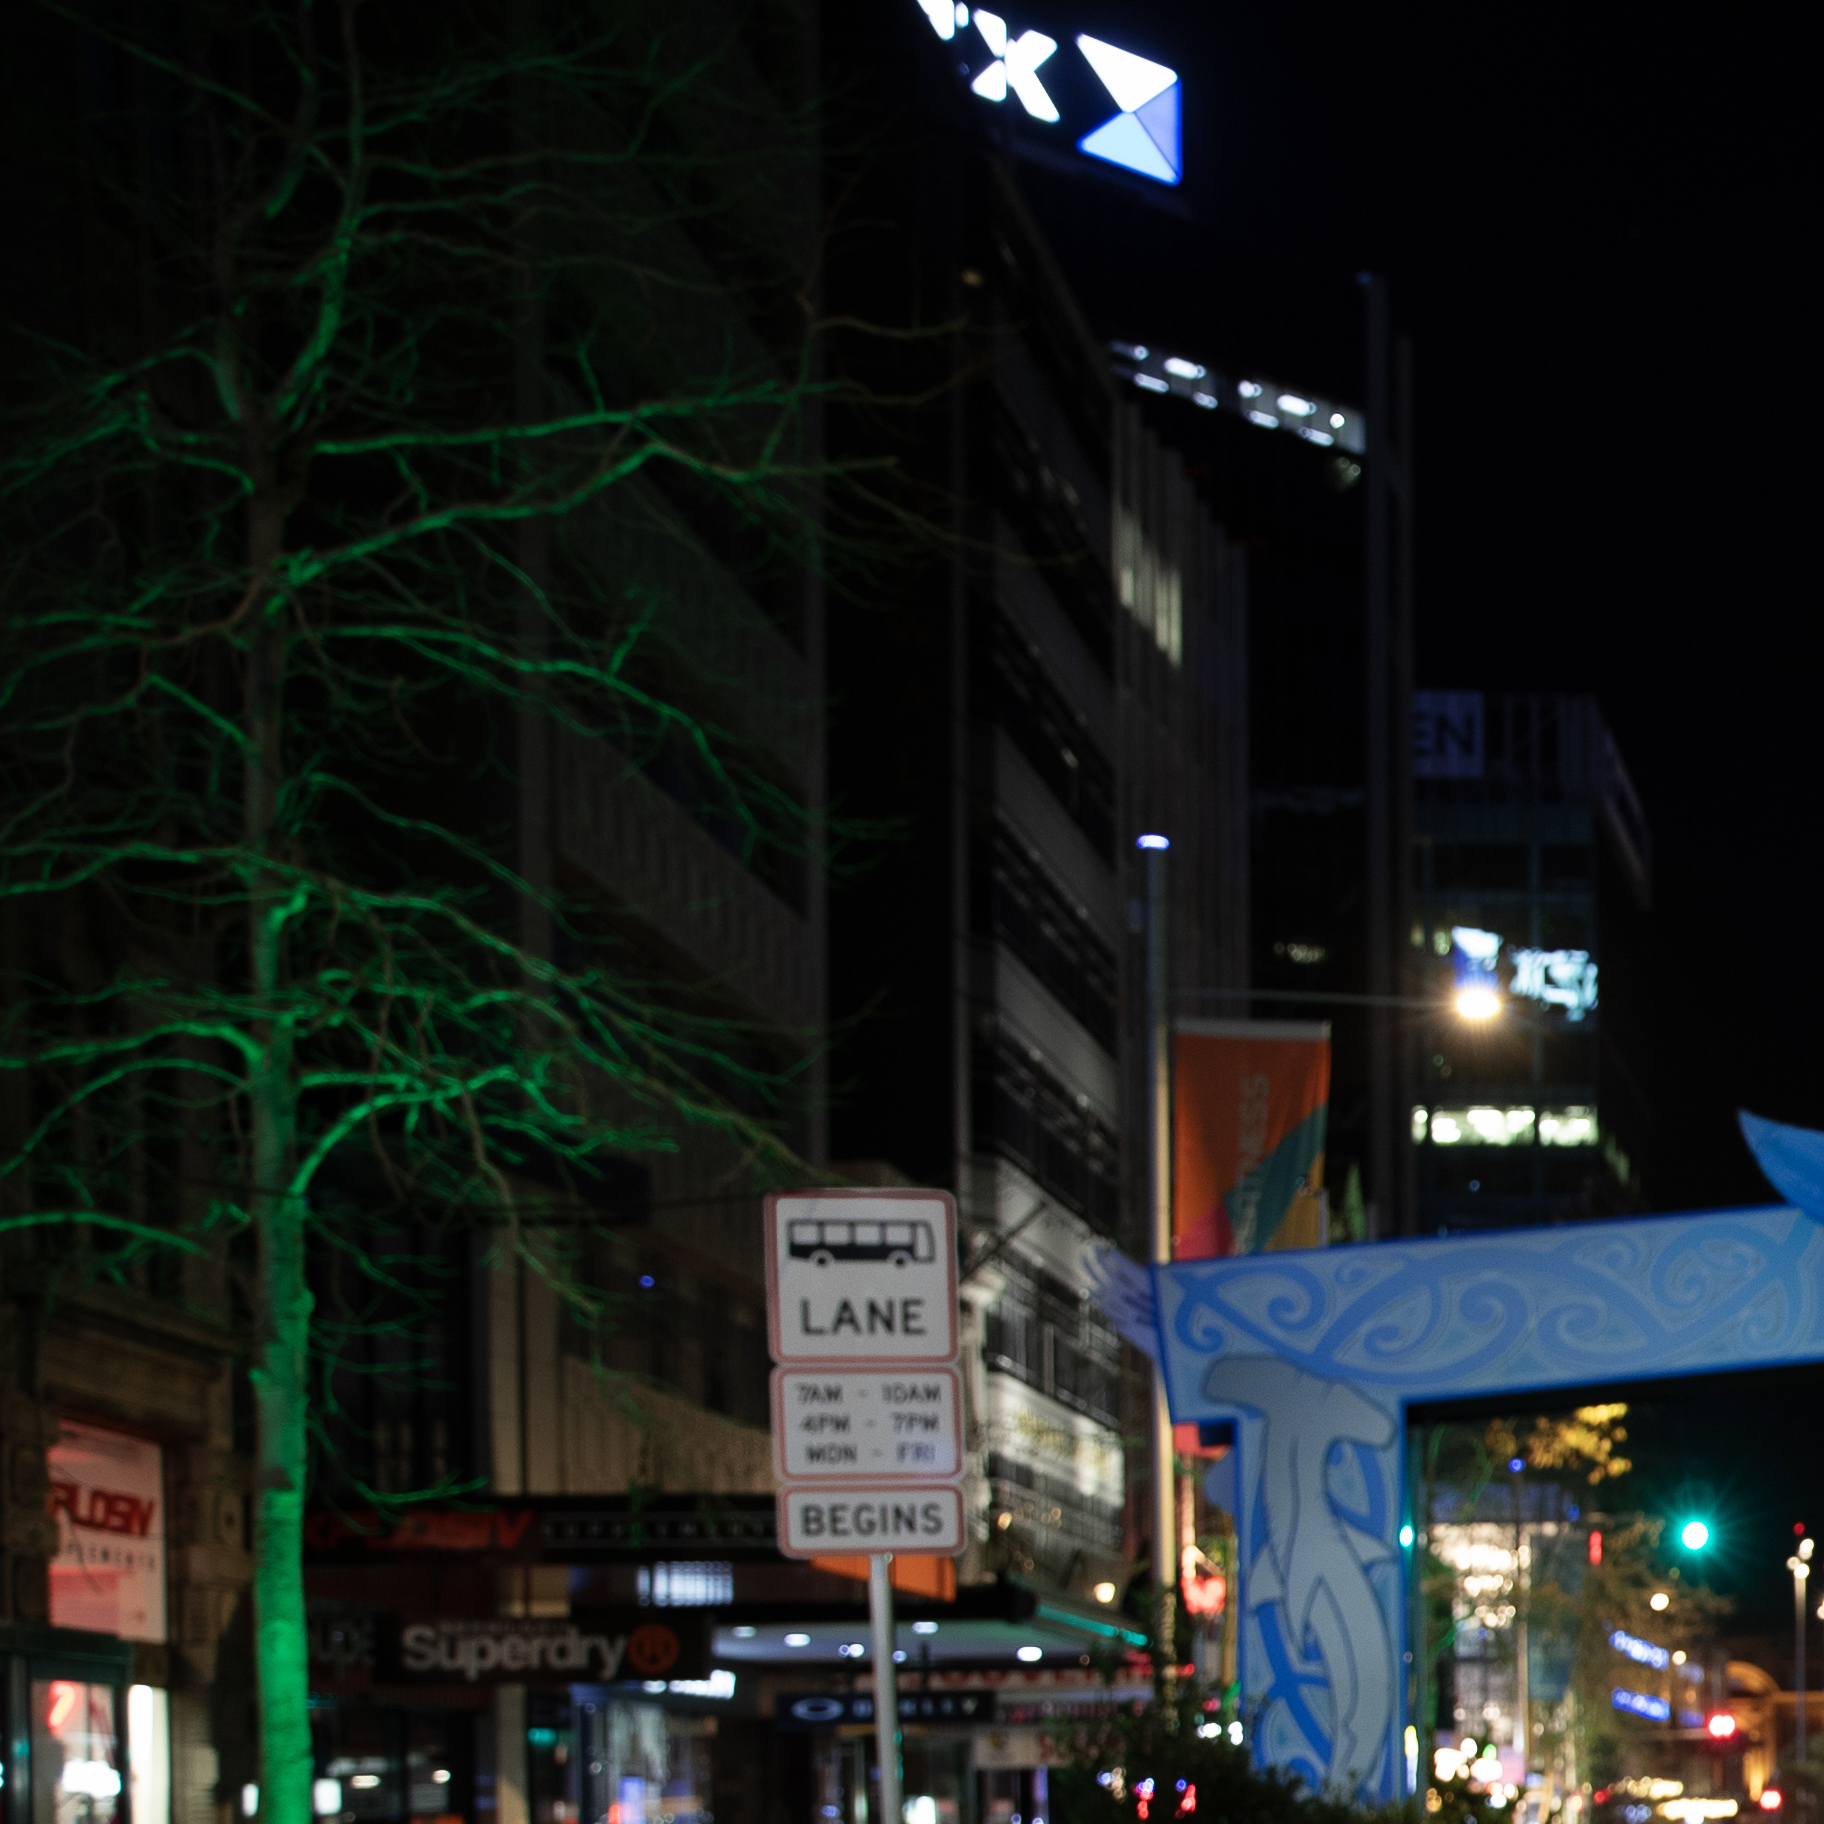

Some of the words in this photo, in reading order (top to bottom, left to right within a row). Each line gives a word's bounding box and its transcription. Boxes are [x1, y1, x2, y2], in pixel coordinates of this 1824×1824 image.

[801, 1297, 927, 1336] LANE
[796, 1382, 843, 1403] 7AM
[892, 1412, 940, 1433] 7PM
[805, 1443, 858, 1464] MON
[896, 1443, 937, 1463] FRI
[802, 1502, 945, 1538] BEGINS
[401, 1623, 628, 1682] Superdry
